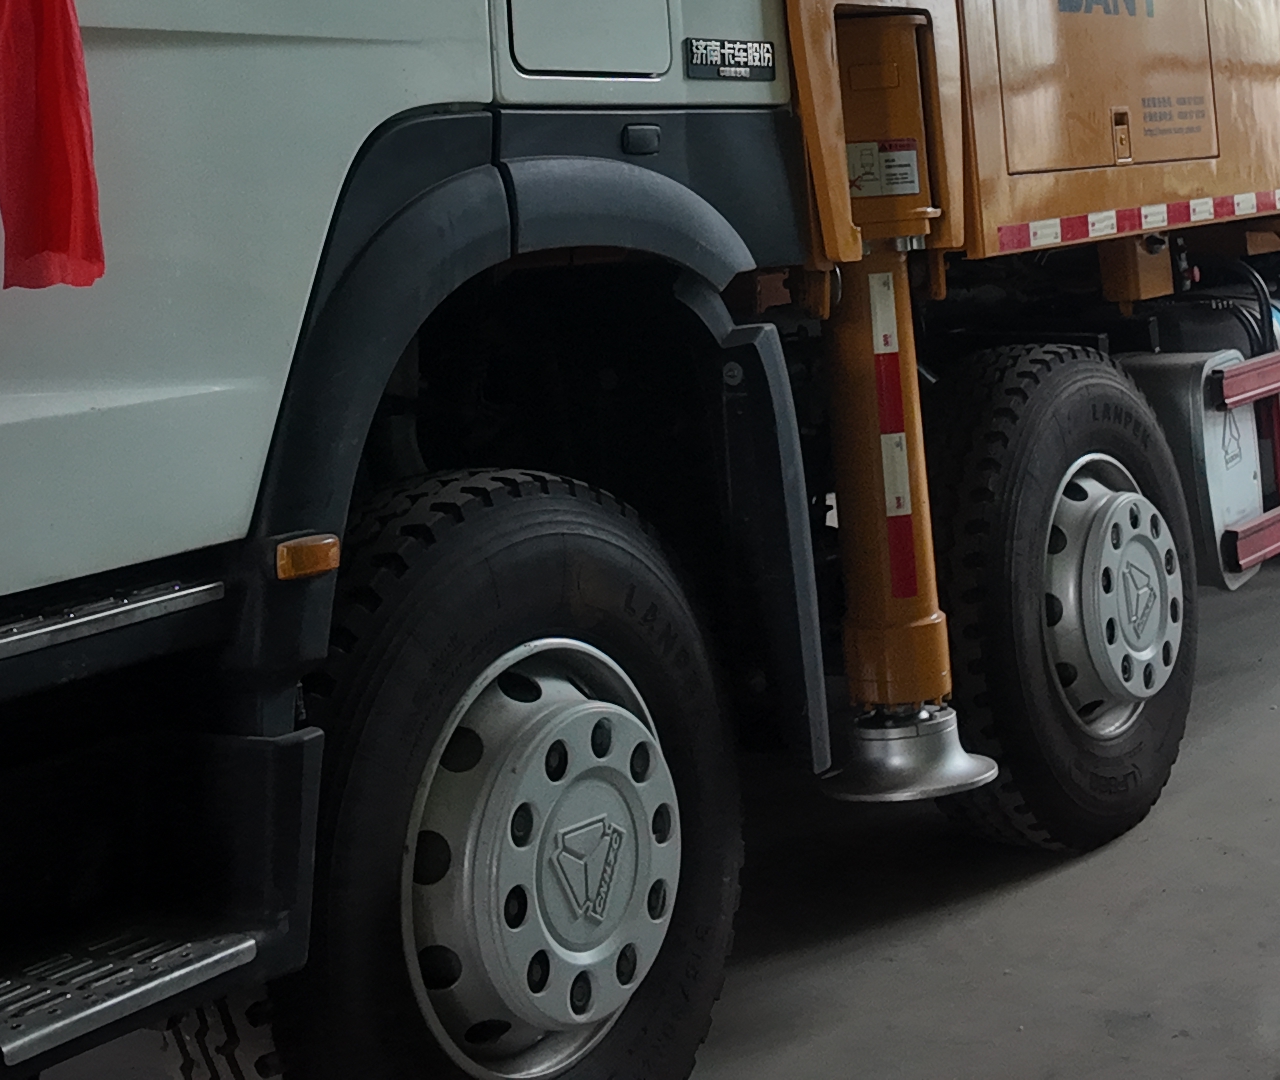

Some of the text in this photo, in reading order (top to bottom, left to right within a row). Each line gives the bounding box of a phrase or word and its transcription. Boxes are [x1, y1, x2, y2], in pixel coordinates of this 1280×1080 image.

[691, 39, 773, 67] 济南卡车股份
